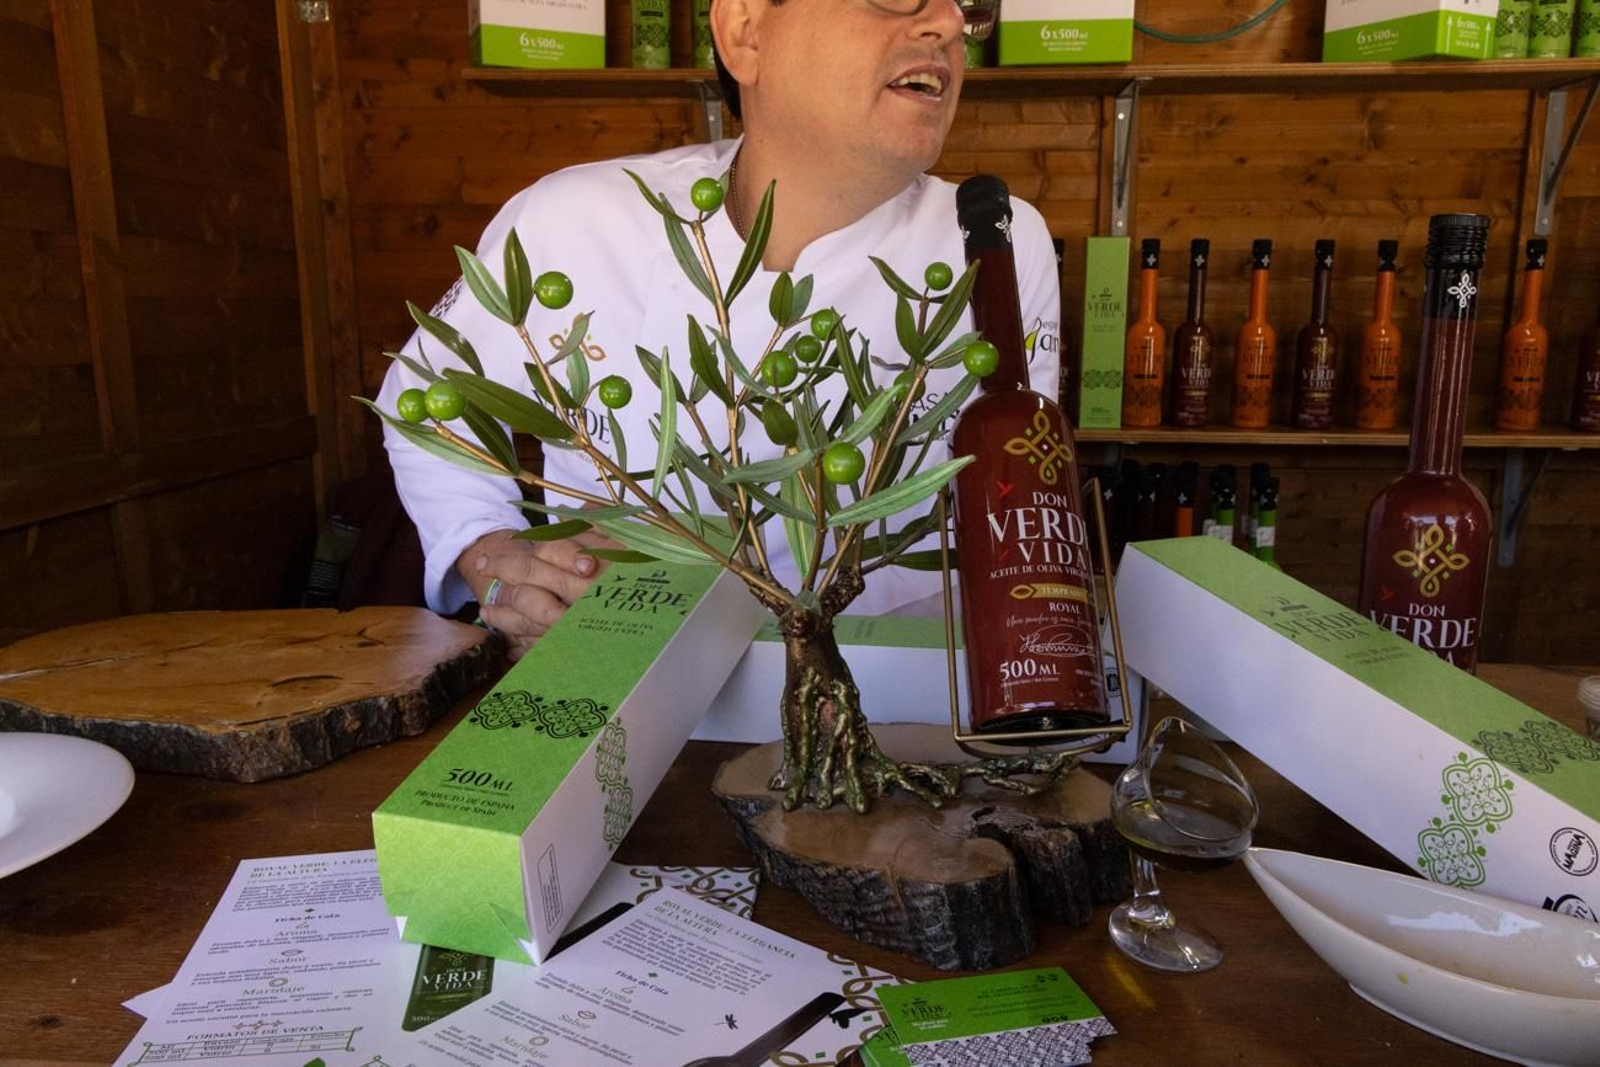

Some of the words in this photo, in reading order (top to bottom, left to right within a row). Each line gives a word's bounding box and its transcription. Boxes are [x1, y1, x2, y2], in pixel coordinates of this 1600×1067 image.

[1032, 492, 1067, 508] DON
[986, 507, 1085, 545] VERD
[1018, 542, 1087, 571] VIDA
[990, 567, 1019, 579] ACEITE
[1023, 565, 1034, 573] DE
[1037, 565, 1062, 573] OLIVA
[595, 585, 693, 606] VERDE
[604, 600, 657, 613] VIDA
[1049, 602, 1081, 614] ROYAL
[1409, 603, 1446, 617] DON
[1370, 610, 1477, 649] VERDE
[423, 969, 487, 985] VERDE
[638, 978, 649, 987] de
